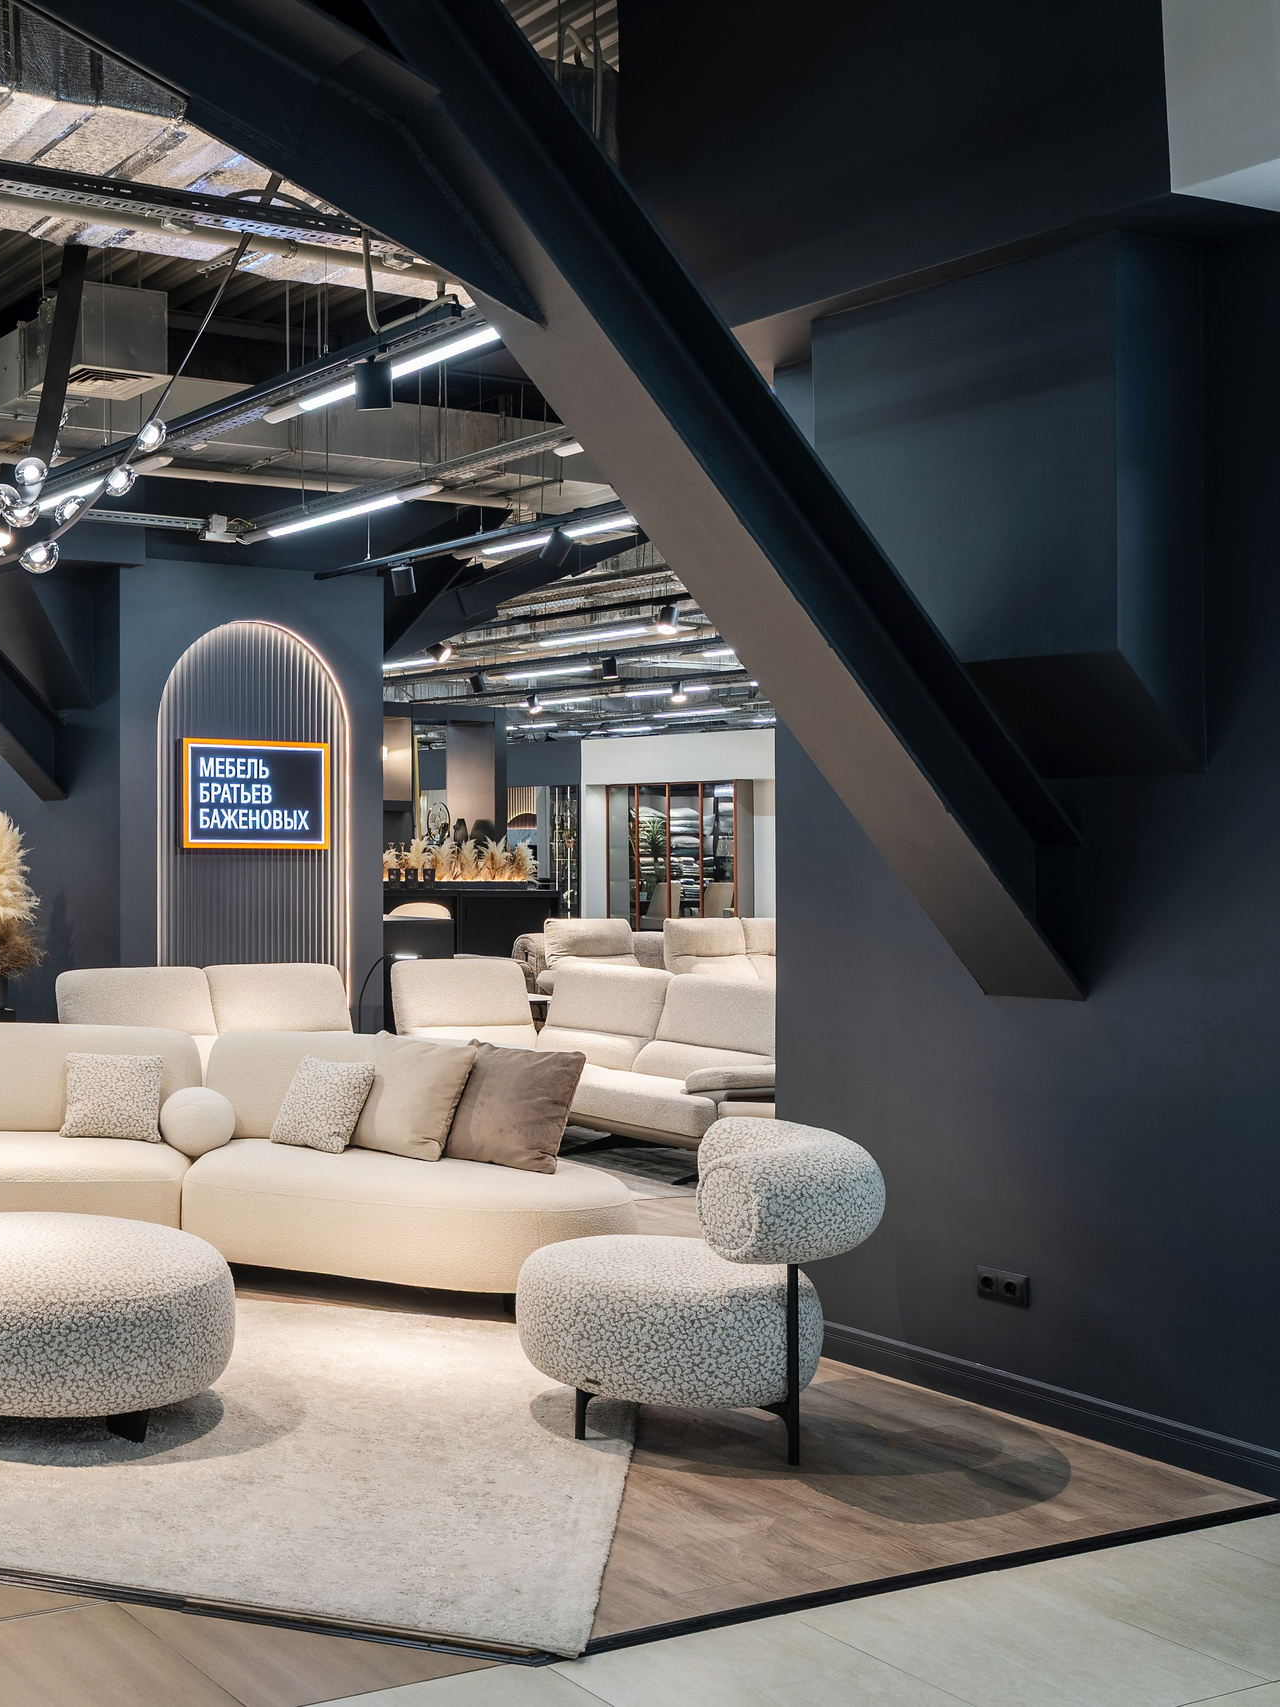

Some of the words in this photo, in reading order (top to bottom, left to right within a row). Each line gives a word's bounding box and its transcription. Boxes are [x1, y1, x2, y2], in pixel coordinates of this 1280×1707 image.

[200, 756, 270, 779] МЕБЕЛЬ
[199, 782, 273, 805] БРАТЬЕВ
[199, 808, 310, 831] БАЖЕНОВЫХ
